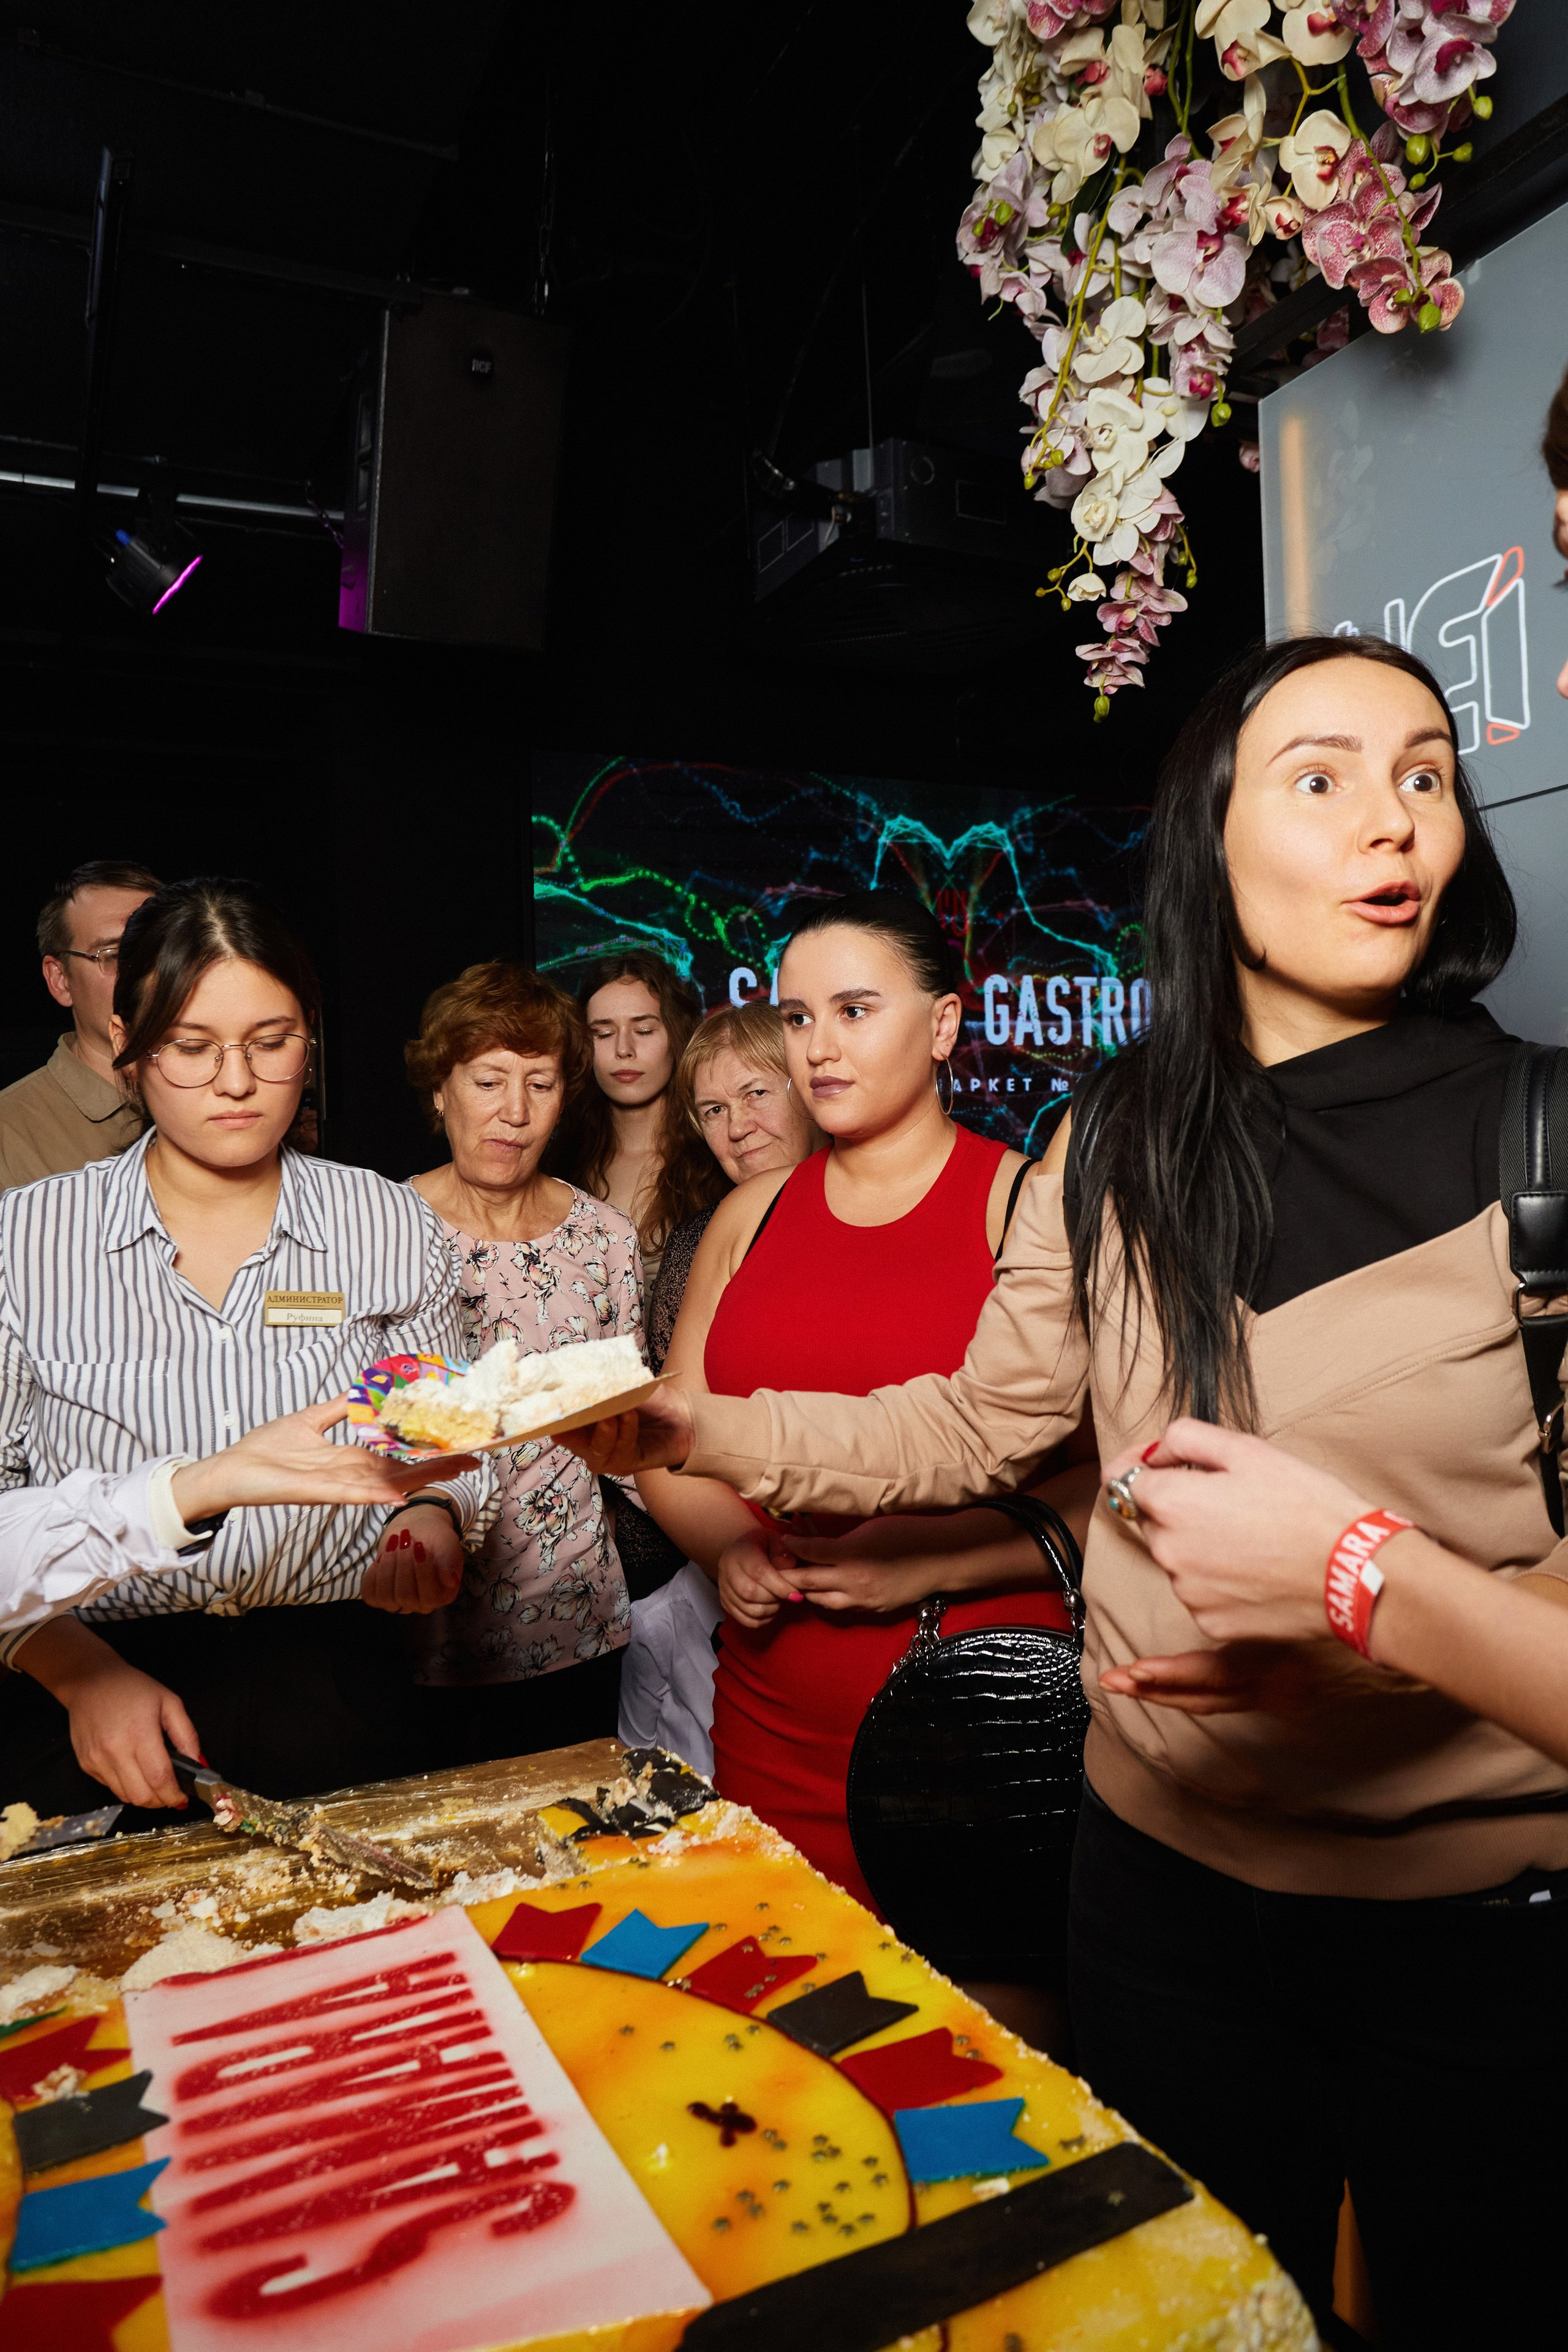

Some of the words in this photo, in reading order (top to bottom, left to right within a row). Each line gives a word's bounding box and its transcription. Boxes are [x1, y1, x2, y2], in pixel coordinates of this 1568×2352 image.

[472, 358, 492, 374] RCF
[938, 1078, 1032, 1092] АРКЕТ
[266, 1295, 343, 1304] АДМИНИСТРАТОР
[287, 1313, 323, 1323] Руфина
[1328, 1521, 1390, 1632] SAMARA
[170, 1951, 577, 2321] SAMARA
